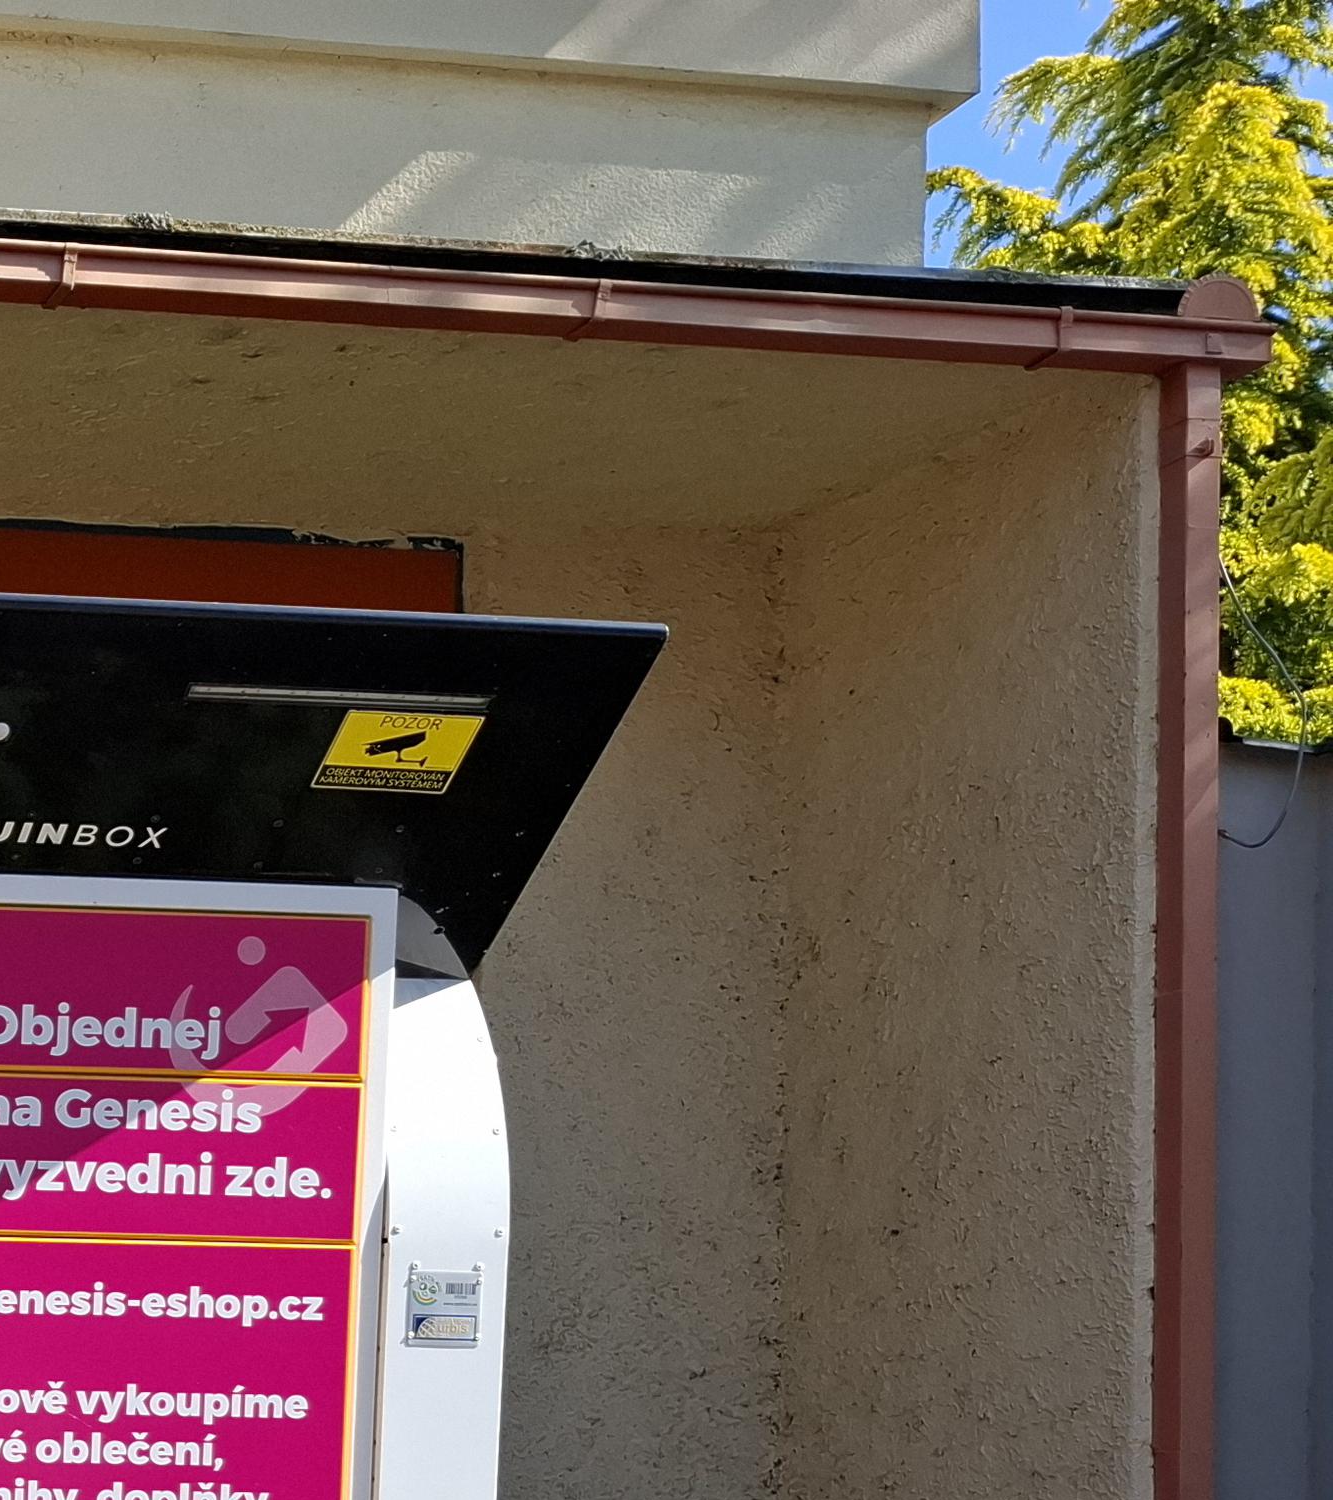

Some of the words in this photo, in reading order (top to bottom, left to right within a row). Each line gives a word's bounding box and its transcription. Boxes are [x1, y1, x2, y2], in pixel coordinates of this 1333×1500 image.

[380, 715, 443, 730] POZOR
[53, 1090, 260, 1134] Genesis
[224, 1157, 332, 1199] zde.
[76, 1386, 308, 1424] vykoupíme
[36, 1429, 223, 1472] oblečení,
